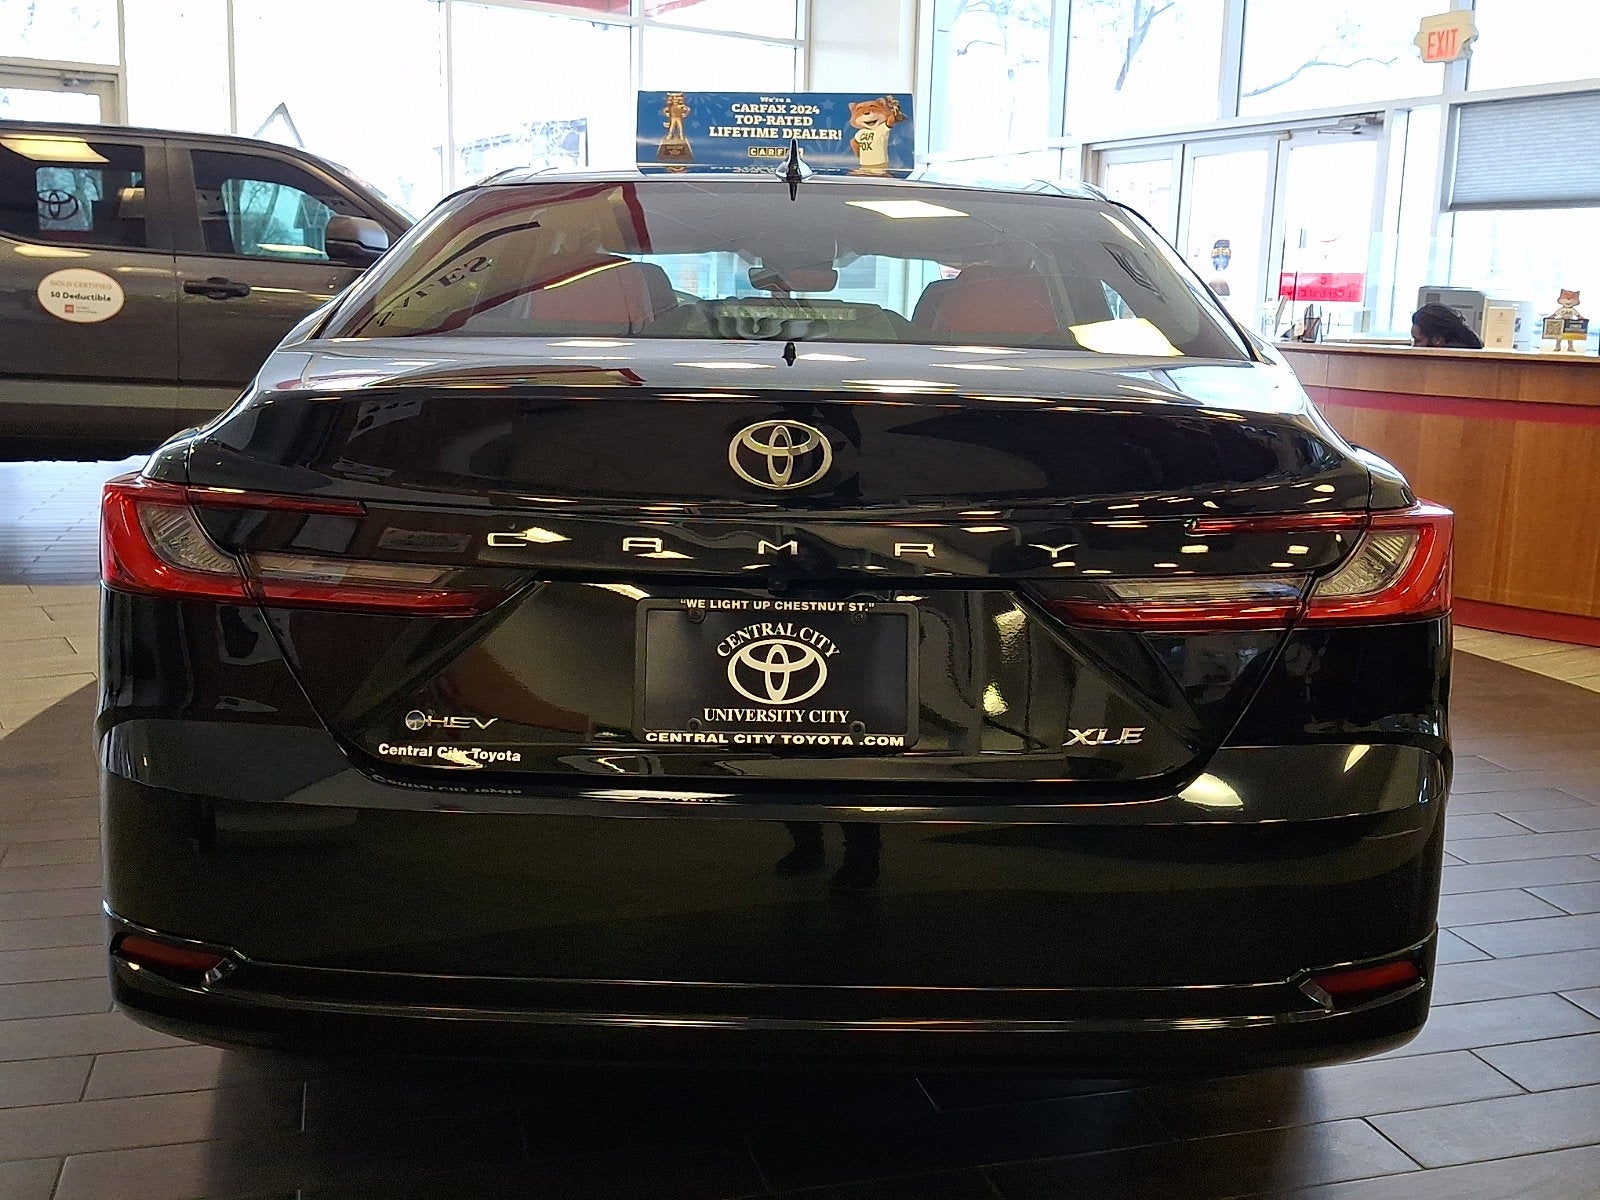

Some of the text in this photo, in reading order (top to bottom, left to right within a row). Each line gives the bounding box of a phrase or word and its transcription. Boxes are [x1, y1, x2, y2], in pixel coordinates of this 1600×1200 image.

[1427, 29, 1458, 59] EXIT
[731, 104, 820, 114] CARFAX 2024
[735, 115, 813, 126] TOP-RATED
[709, 127, 842, 140] LIFETIME DEALER!
[748, 147, 804, 157] CARF
[63, 292, 111, 302] Deductible
[487, 532, 1079, 559] CAMRY
[710, 600, 749, 610] LIGHT
[753, 601, 771, 610] UP
[775, 601, 844, 612] CHESTNUT
[716, 622, 841, 659] CENTRAL CITY
[427, 716, 498, 729] HEV
[703, 708, 850, 724] UNIVERSITY CITY
[645, 733, 905, 747] CENTRAL CITY TOYOTA .COM
[1062, 727, 1146, 746] XLE
[378, 743, 433, 757] Central
[472, 748, 521, 762] Toyota
